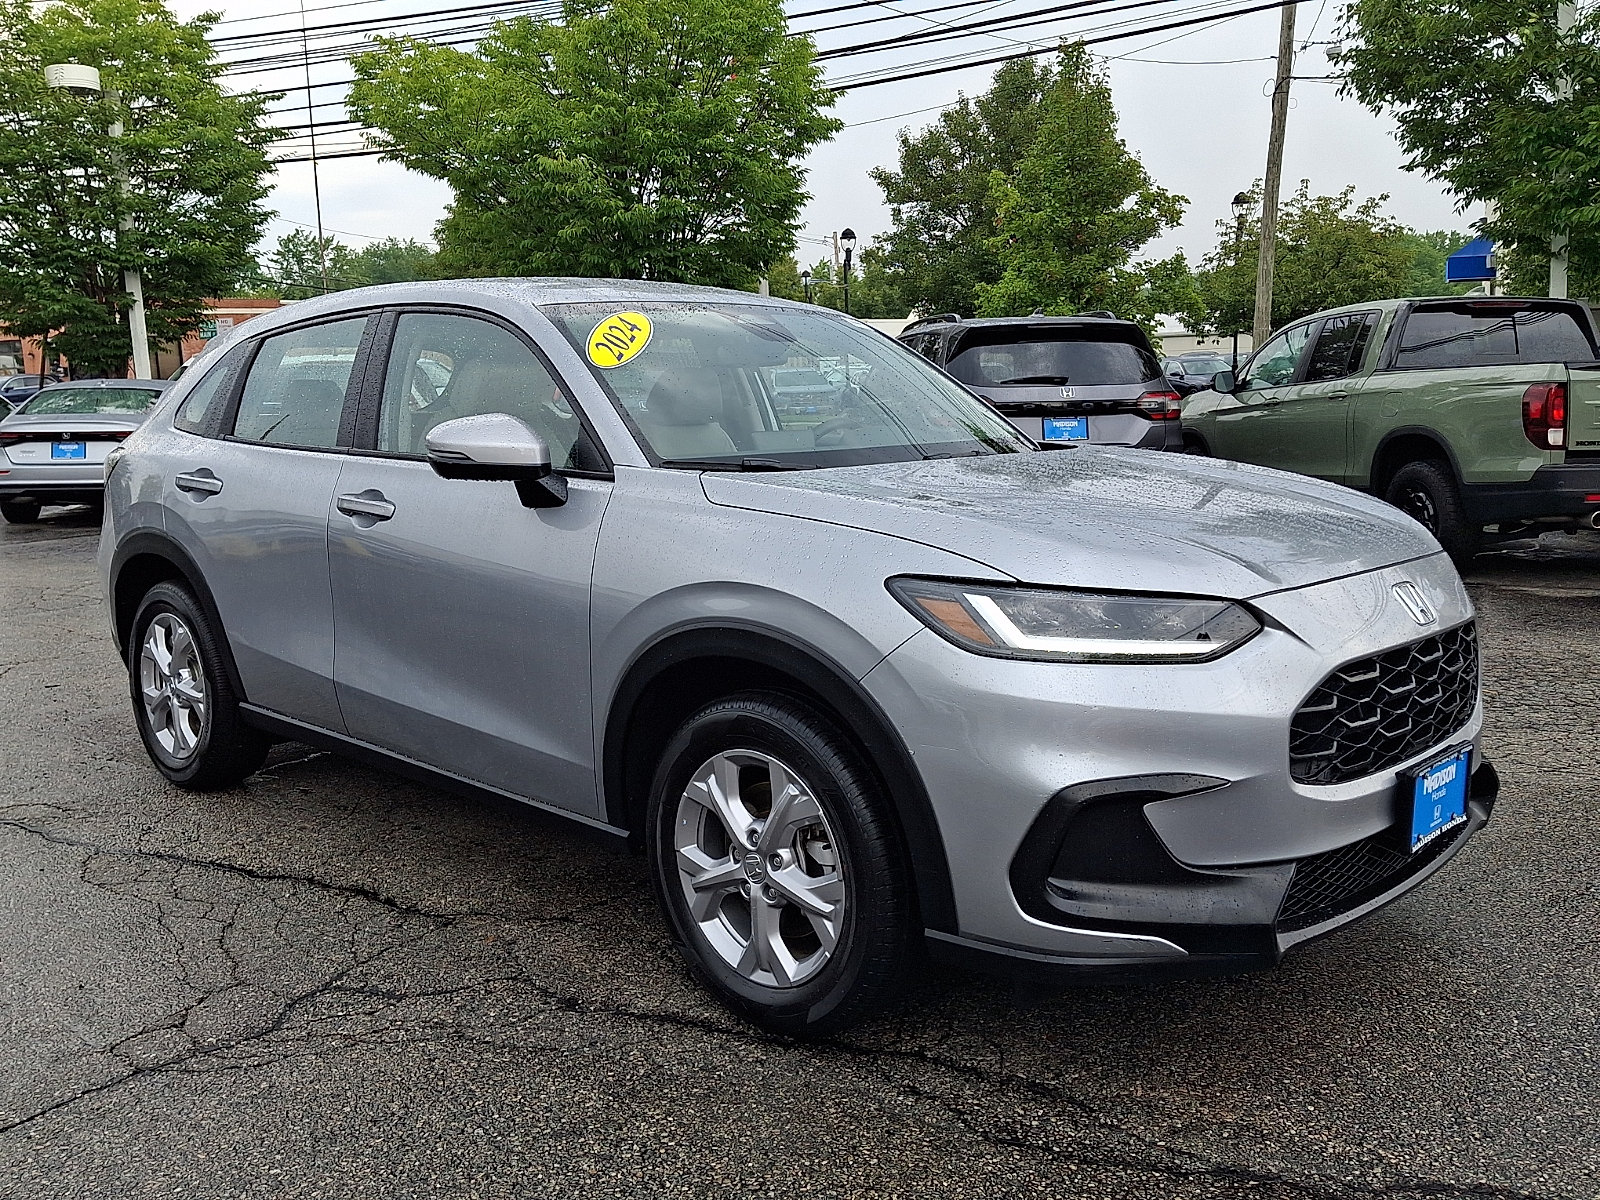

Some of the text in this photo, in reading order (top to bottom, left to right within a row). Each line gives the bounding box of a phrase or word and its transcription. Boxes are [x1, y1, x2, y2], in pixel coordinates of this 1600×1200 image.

[595, 316, 641, 361] 2024
[1423, 763, 1457, 795] MADISON
[1432, 786, 1447, 802] Honda
[1412, 815, 1468, 853] MADISON HONDA
